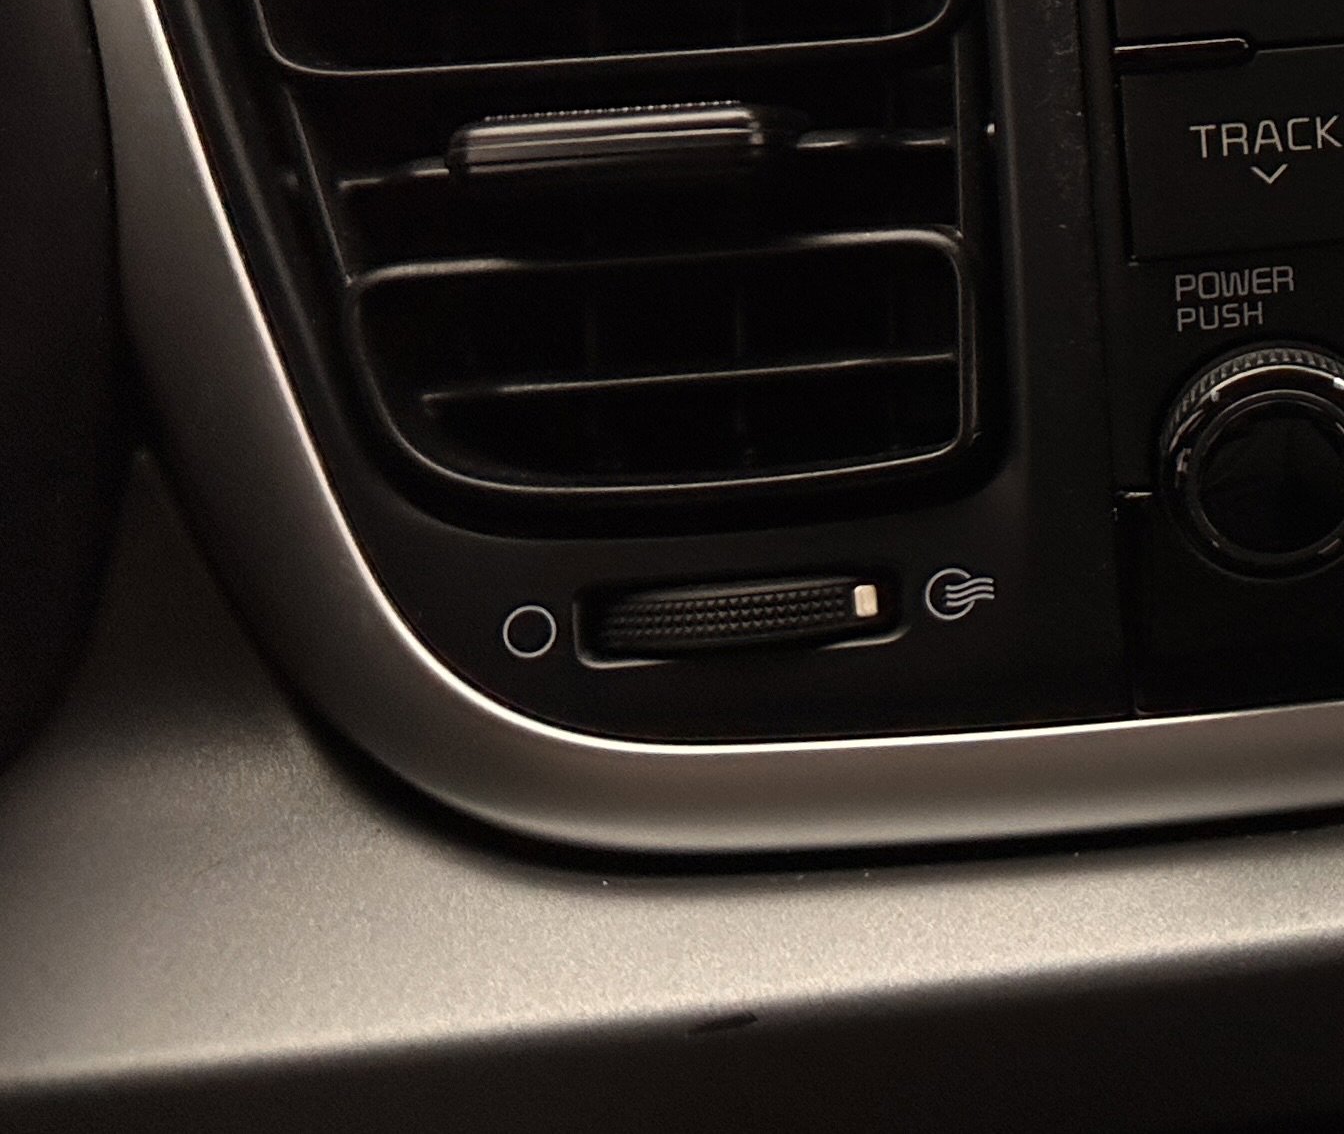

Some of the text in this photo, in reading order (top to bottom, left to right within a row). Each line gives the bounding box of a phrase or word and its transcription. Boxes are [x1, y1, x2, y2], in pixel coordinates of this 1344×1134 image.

[1190, 115, 1344, 159] TRACK
[1174, 266, 1295, 302] POWER
[1176, 300, 1264, 332] PUSH
